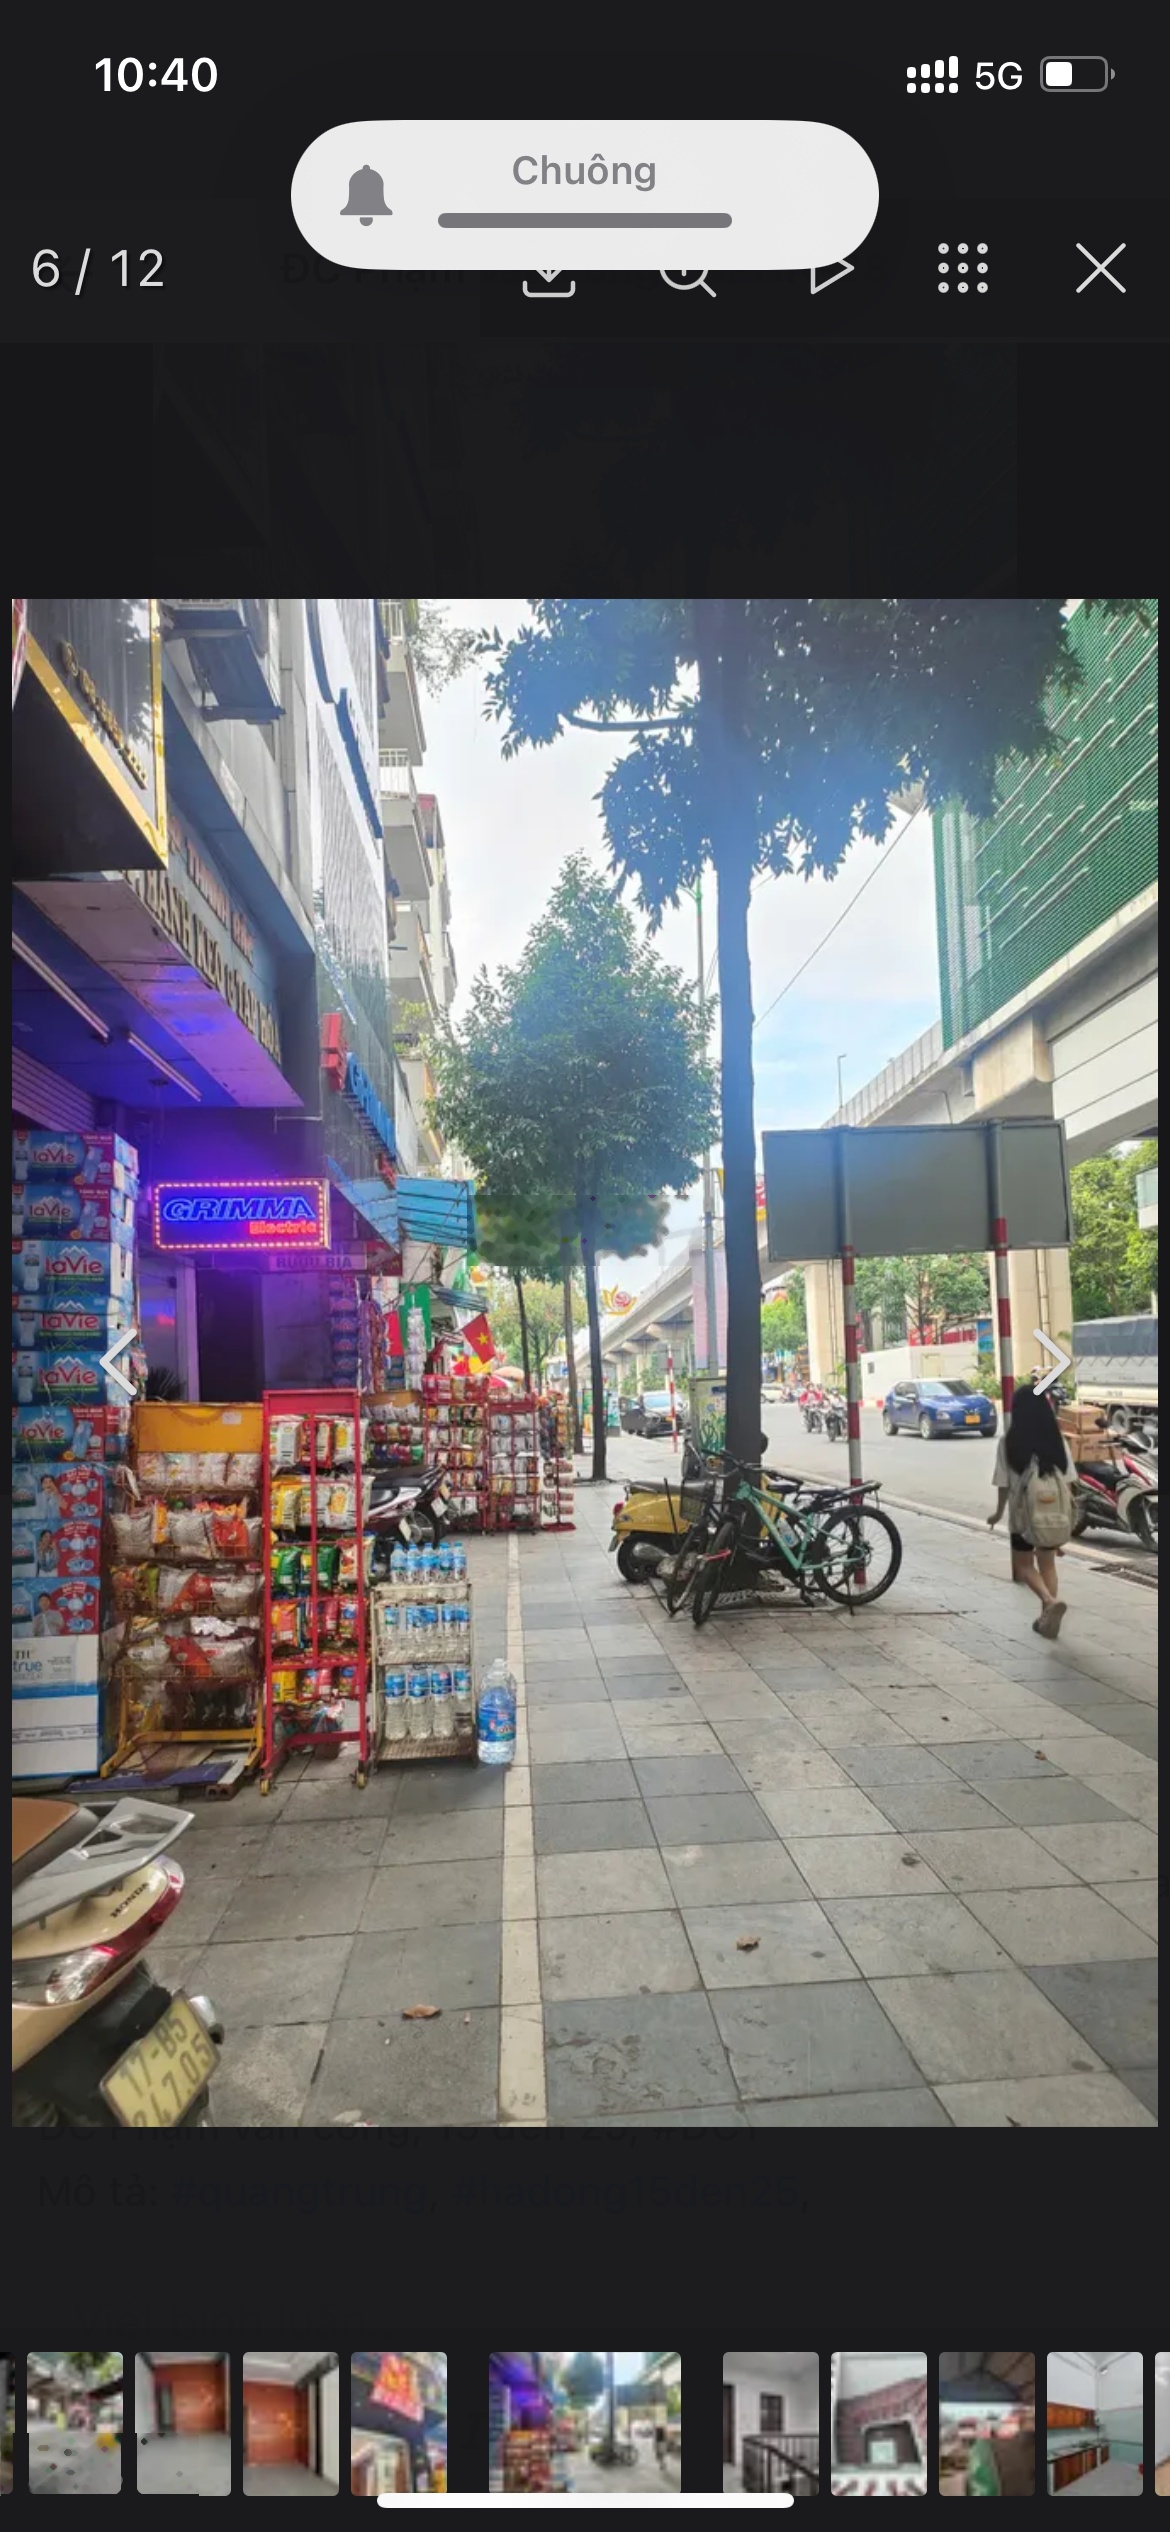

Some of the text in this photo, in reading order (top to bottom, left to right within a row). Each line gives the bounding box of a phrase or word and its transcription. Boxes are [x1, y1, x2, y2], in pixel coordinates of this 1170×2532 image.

[163, 1197, 316, 1221] GRIMMA
[249, 1221, 317, 1235] Electric
[325, 1257, 352, 1269] BIA
[12, 1659, 43, 1672] true
[110, 1881, 150, 1918] HONDA
